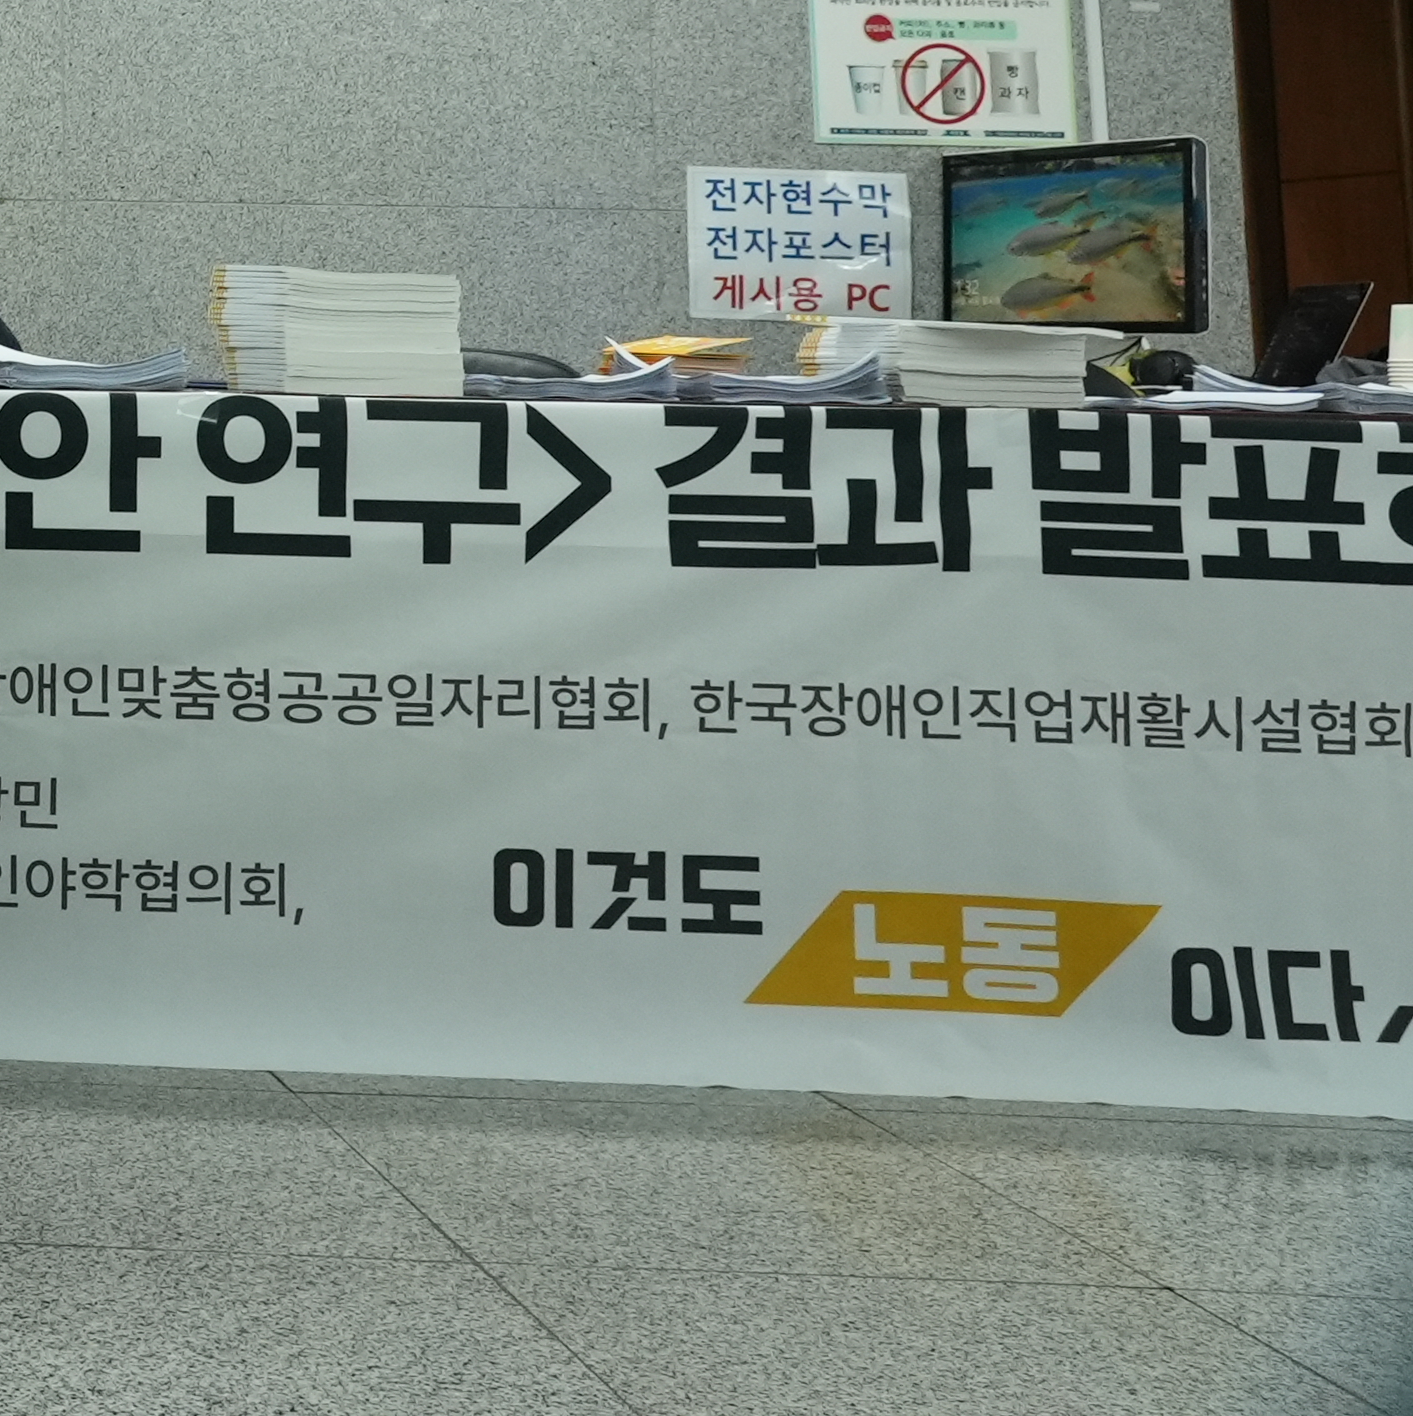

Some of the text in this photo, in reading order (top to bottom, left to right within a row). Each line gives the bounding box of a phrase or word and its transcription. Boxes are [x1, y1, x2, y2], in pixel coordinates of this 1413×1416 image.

[953, 87, 966, 101] 캔
[705, 178, 892, 219] 전자현수막
[706, 225, 892, 267] 전자포스터
[713, 274, 892, 313] 게시용 PC
[195, 395, 613, 565] 연구>
[655, 406, 993, 572] 결과
[690, 677, 1413, 760] 한국장애인직업재활시설협회
[493, 847, 764, 937] 이것도
[852, 902, 1062, 1003] 노동
